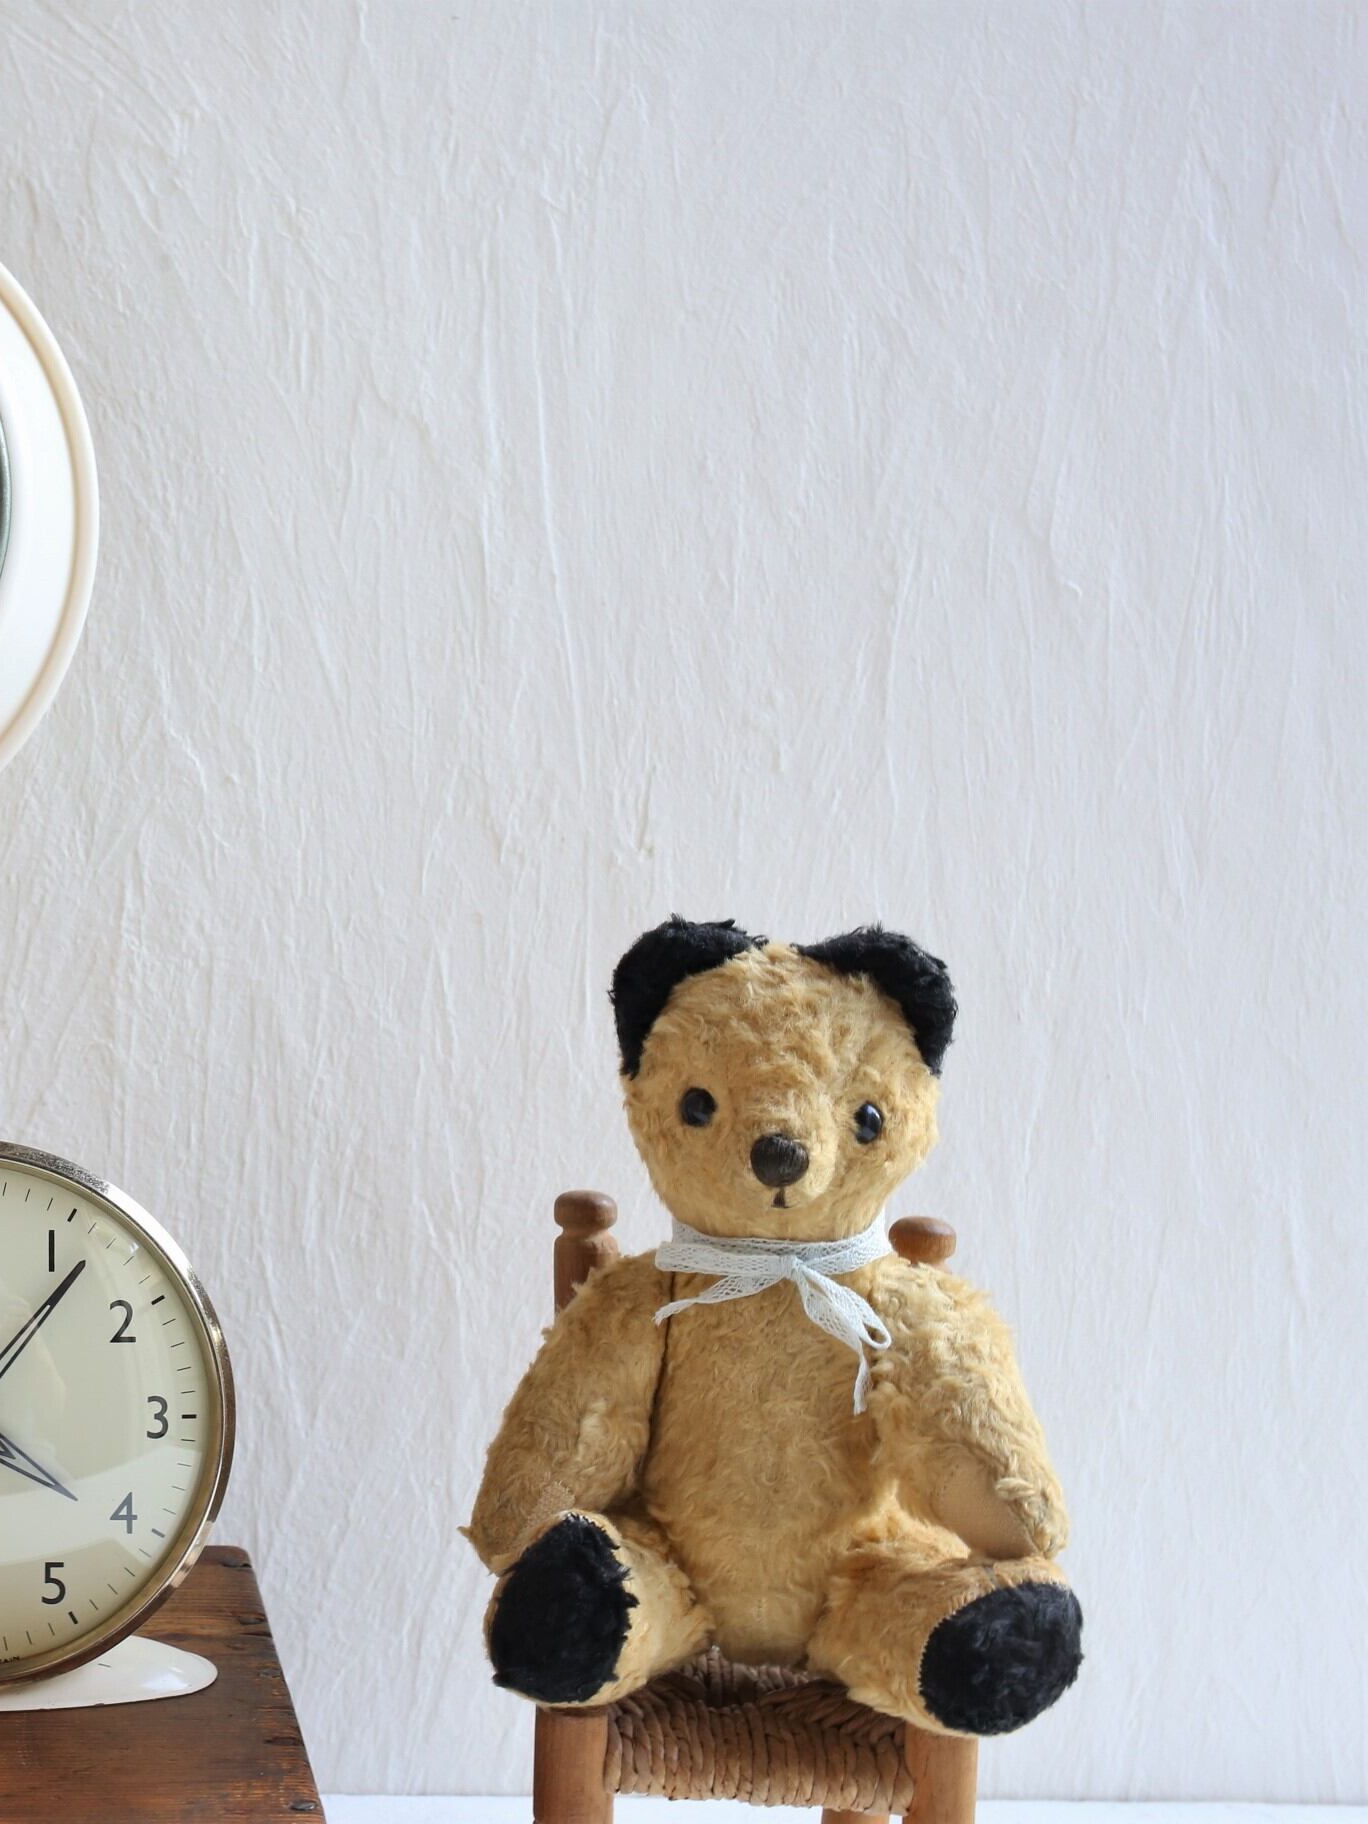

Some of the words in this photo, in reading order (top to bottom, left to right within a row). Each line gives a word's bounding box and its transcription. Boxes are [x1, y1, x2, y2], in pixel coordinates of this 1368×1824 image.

[48, 1230, 55, 1272] 1
[109, 1300, 136, 1343] 2
[146, 1396, 169, 1439] 3
[109, 1491, 138, 1534] 4
[41, 1562, 66, 1605] 5
